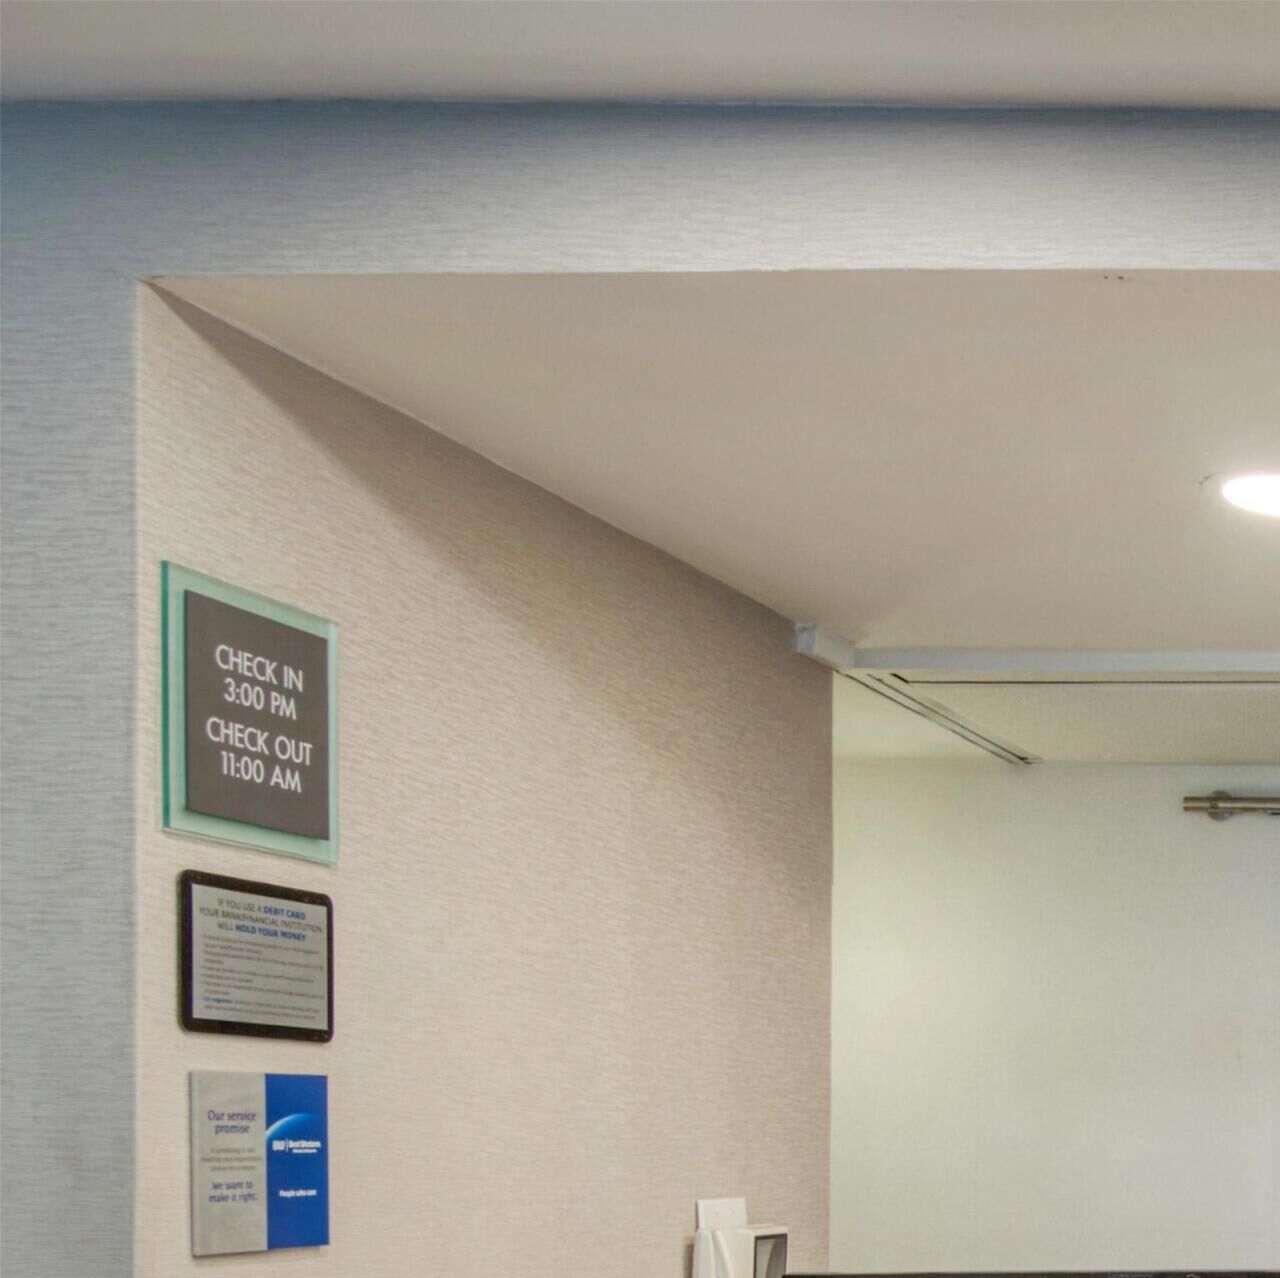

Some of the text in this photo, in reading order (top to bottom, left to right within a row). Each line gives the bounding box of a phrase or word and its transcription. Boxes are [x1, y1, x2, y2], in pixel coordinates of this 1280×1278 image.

[215, 644, 303, 692] CHECK IN
[224, 679, 296, 720] 3:00 PM
[206, 717, 313, 765] CHECK OUT
[220, 751, 301, 792] 11:00 AM
